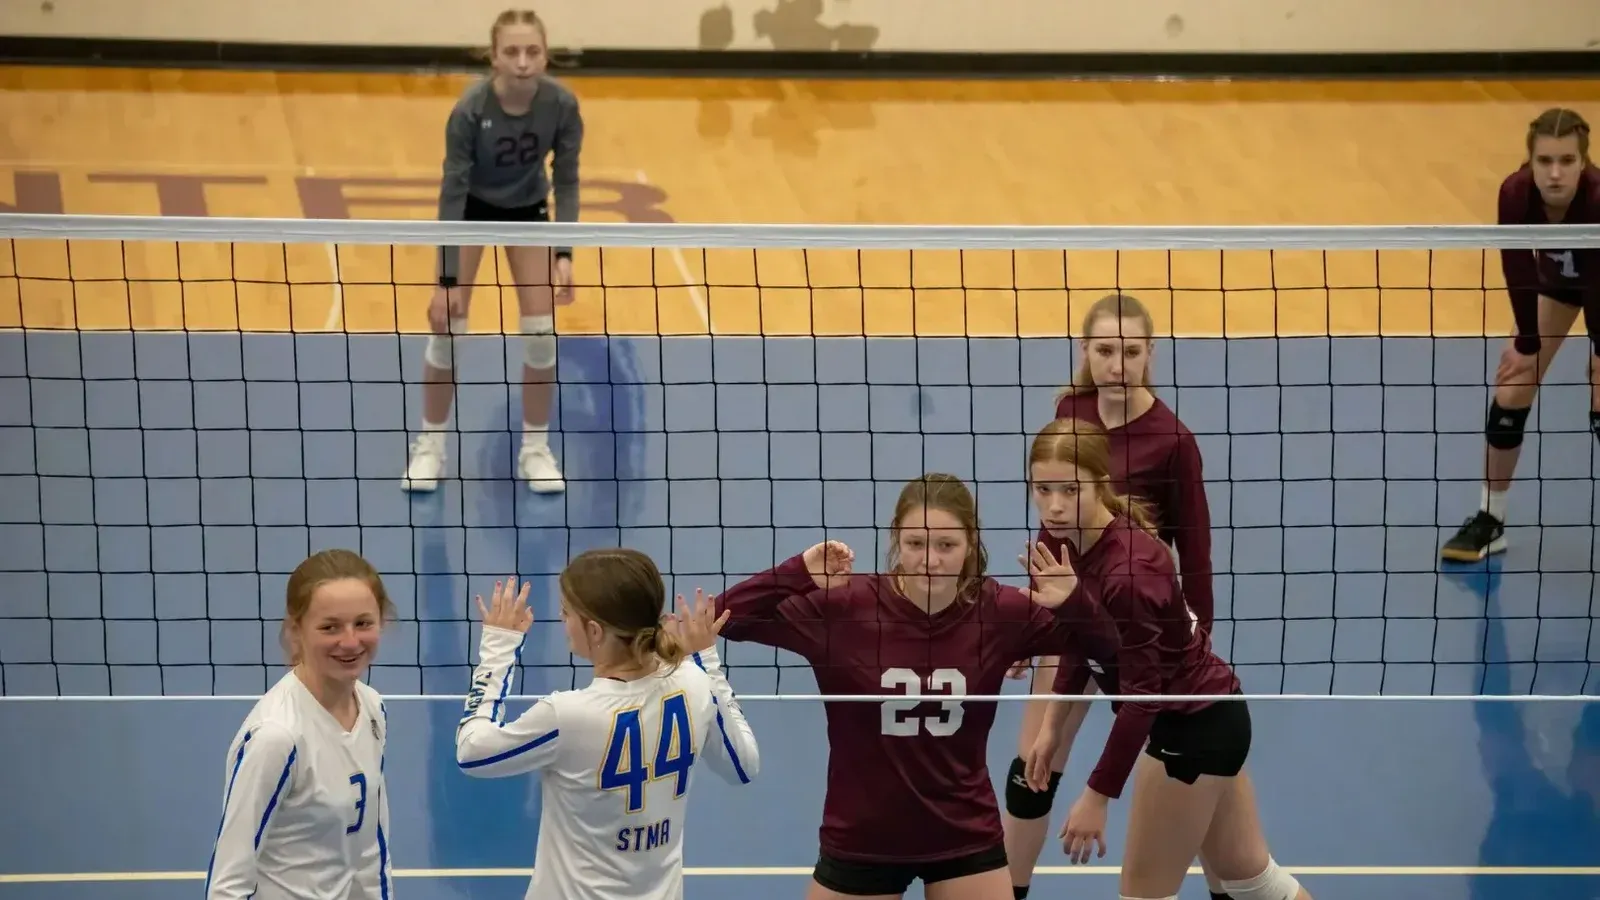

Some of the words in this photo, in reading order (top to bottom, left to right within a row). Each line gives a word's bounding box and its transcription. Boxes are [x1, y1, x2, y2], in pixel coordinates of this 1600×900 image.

[495, 132, 539, 168] 22
[880, 667, 967, 737] 23
[598, 690, 697, 814] 44
[346, 772, 367, 835] 3
[616, 818, 671, 852] STMA
